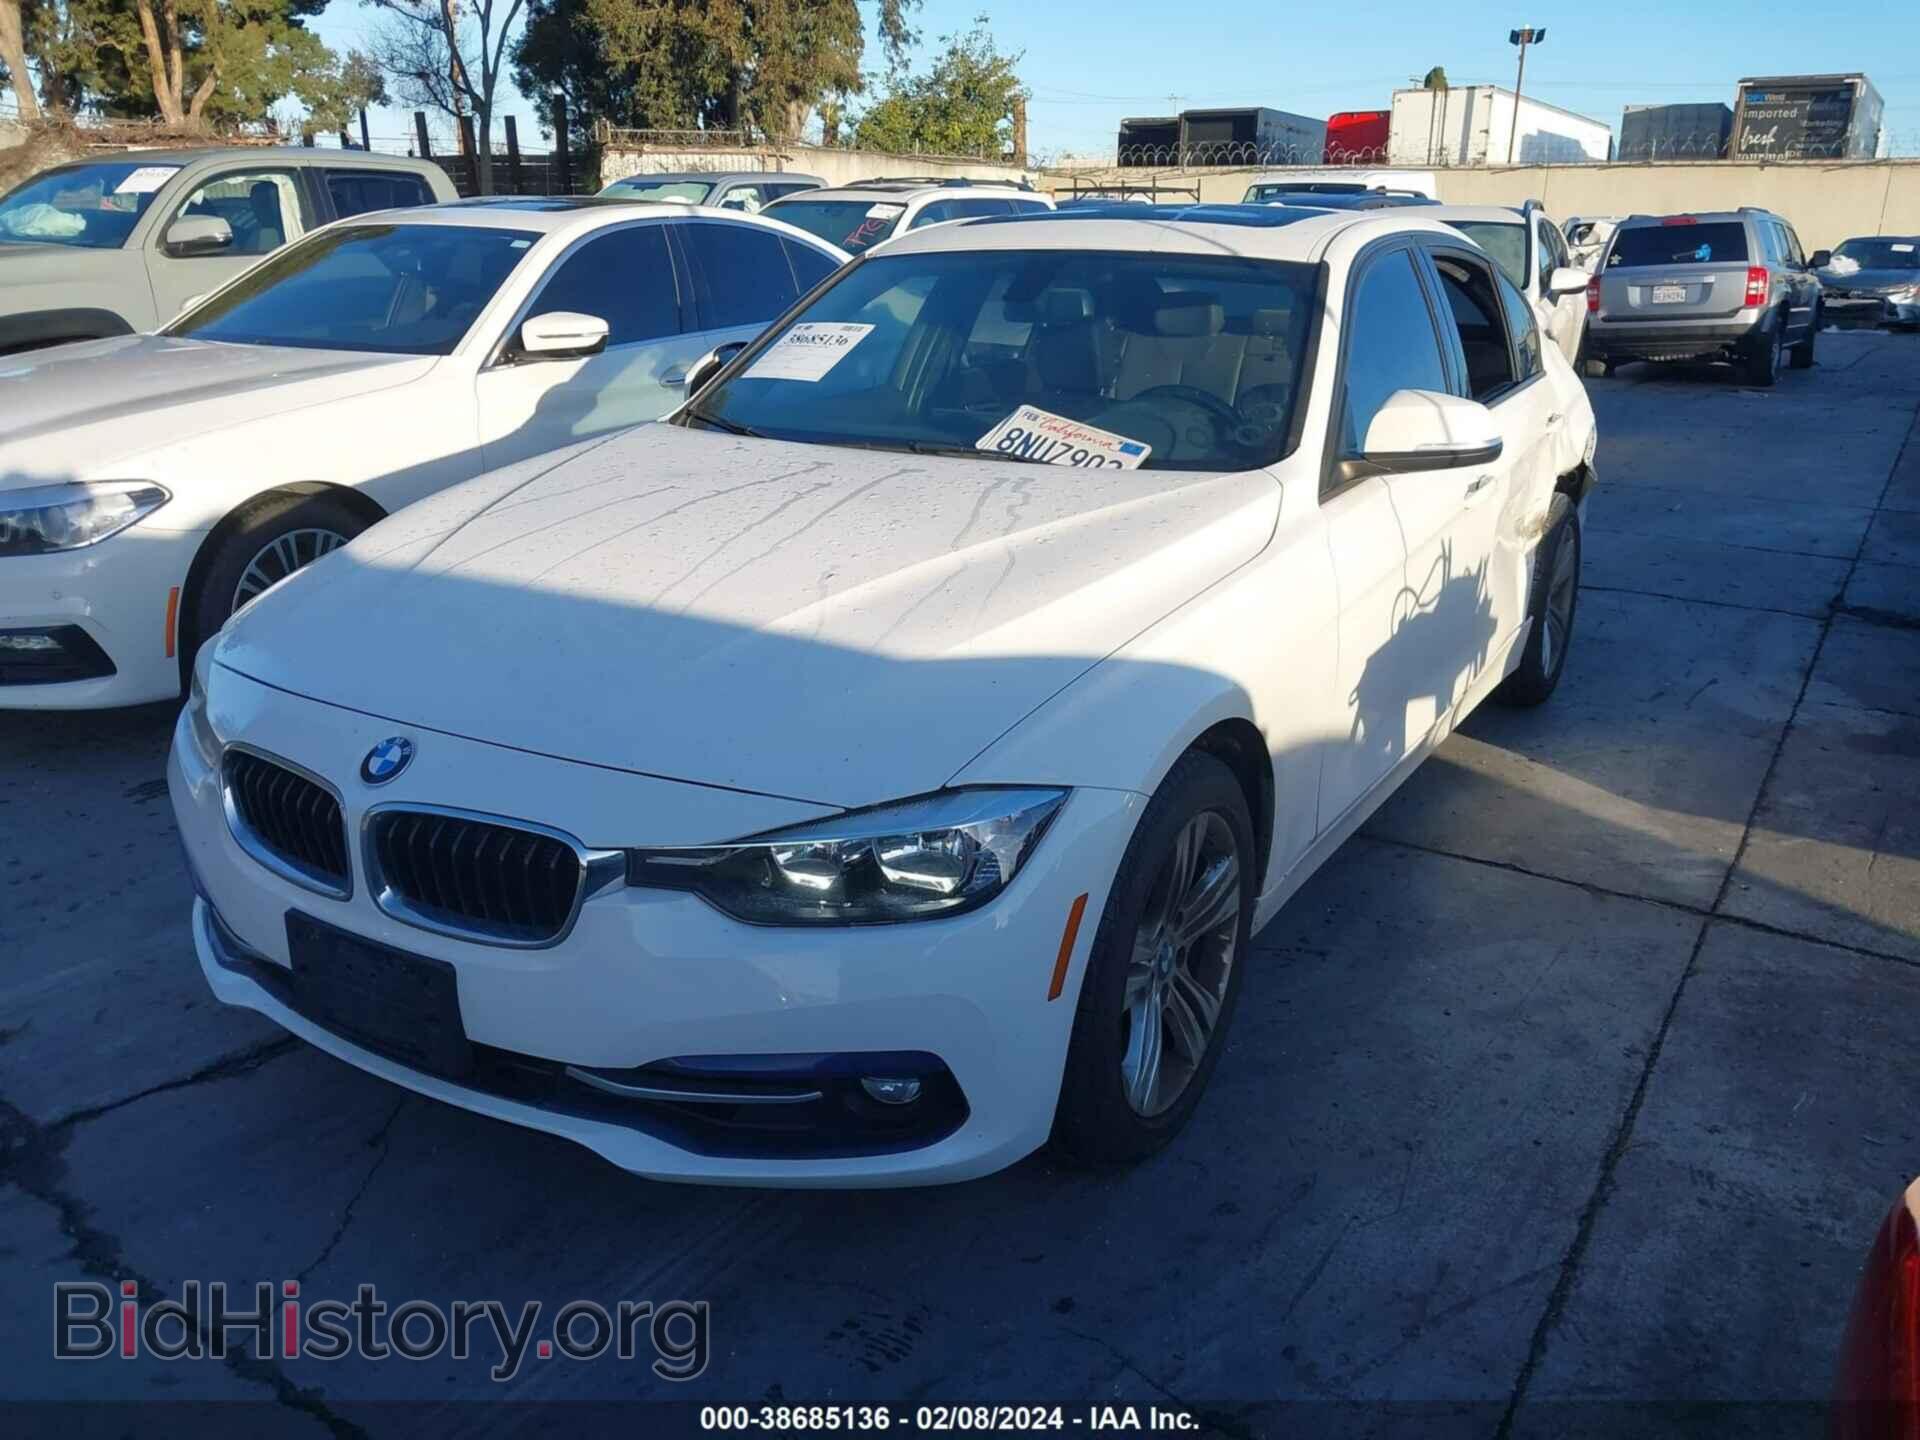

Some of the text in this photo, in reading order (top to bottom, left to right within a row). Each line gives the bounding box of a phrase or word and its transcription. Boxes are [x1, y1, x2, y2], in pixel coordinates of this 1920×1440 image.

[1743, 107, 1799, 121] imported
[1022, 410, 1116, 450] FEB California
